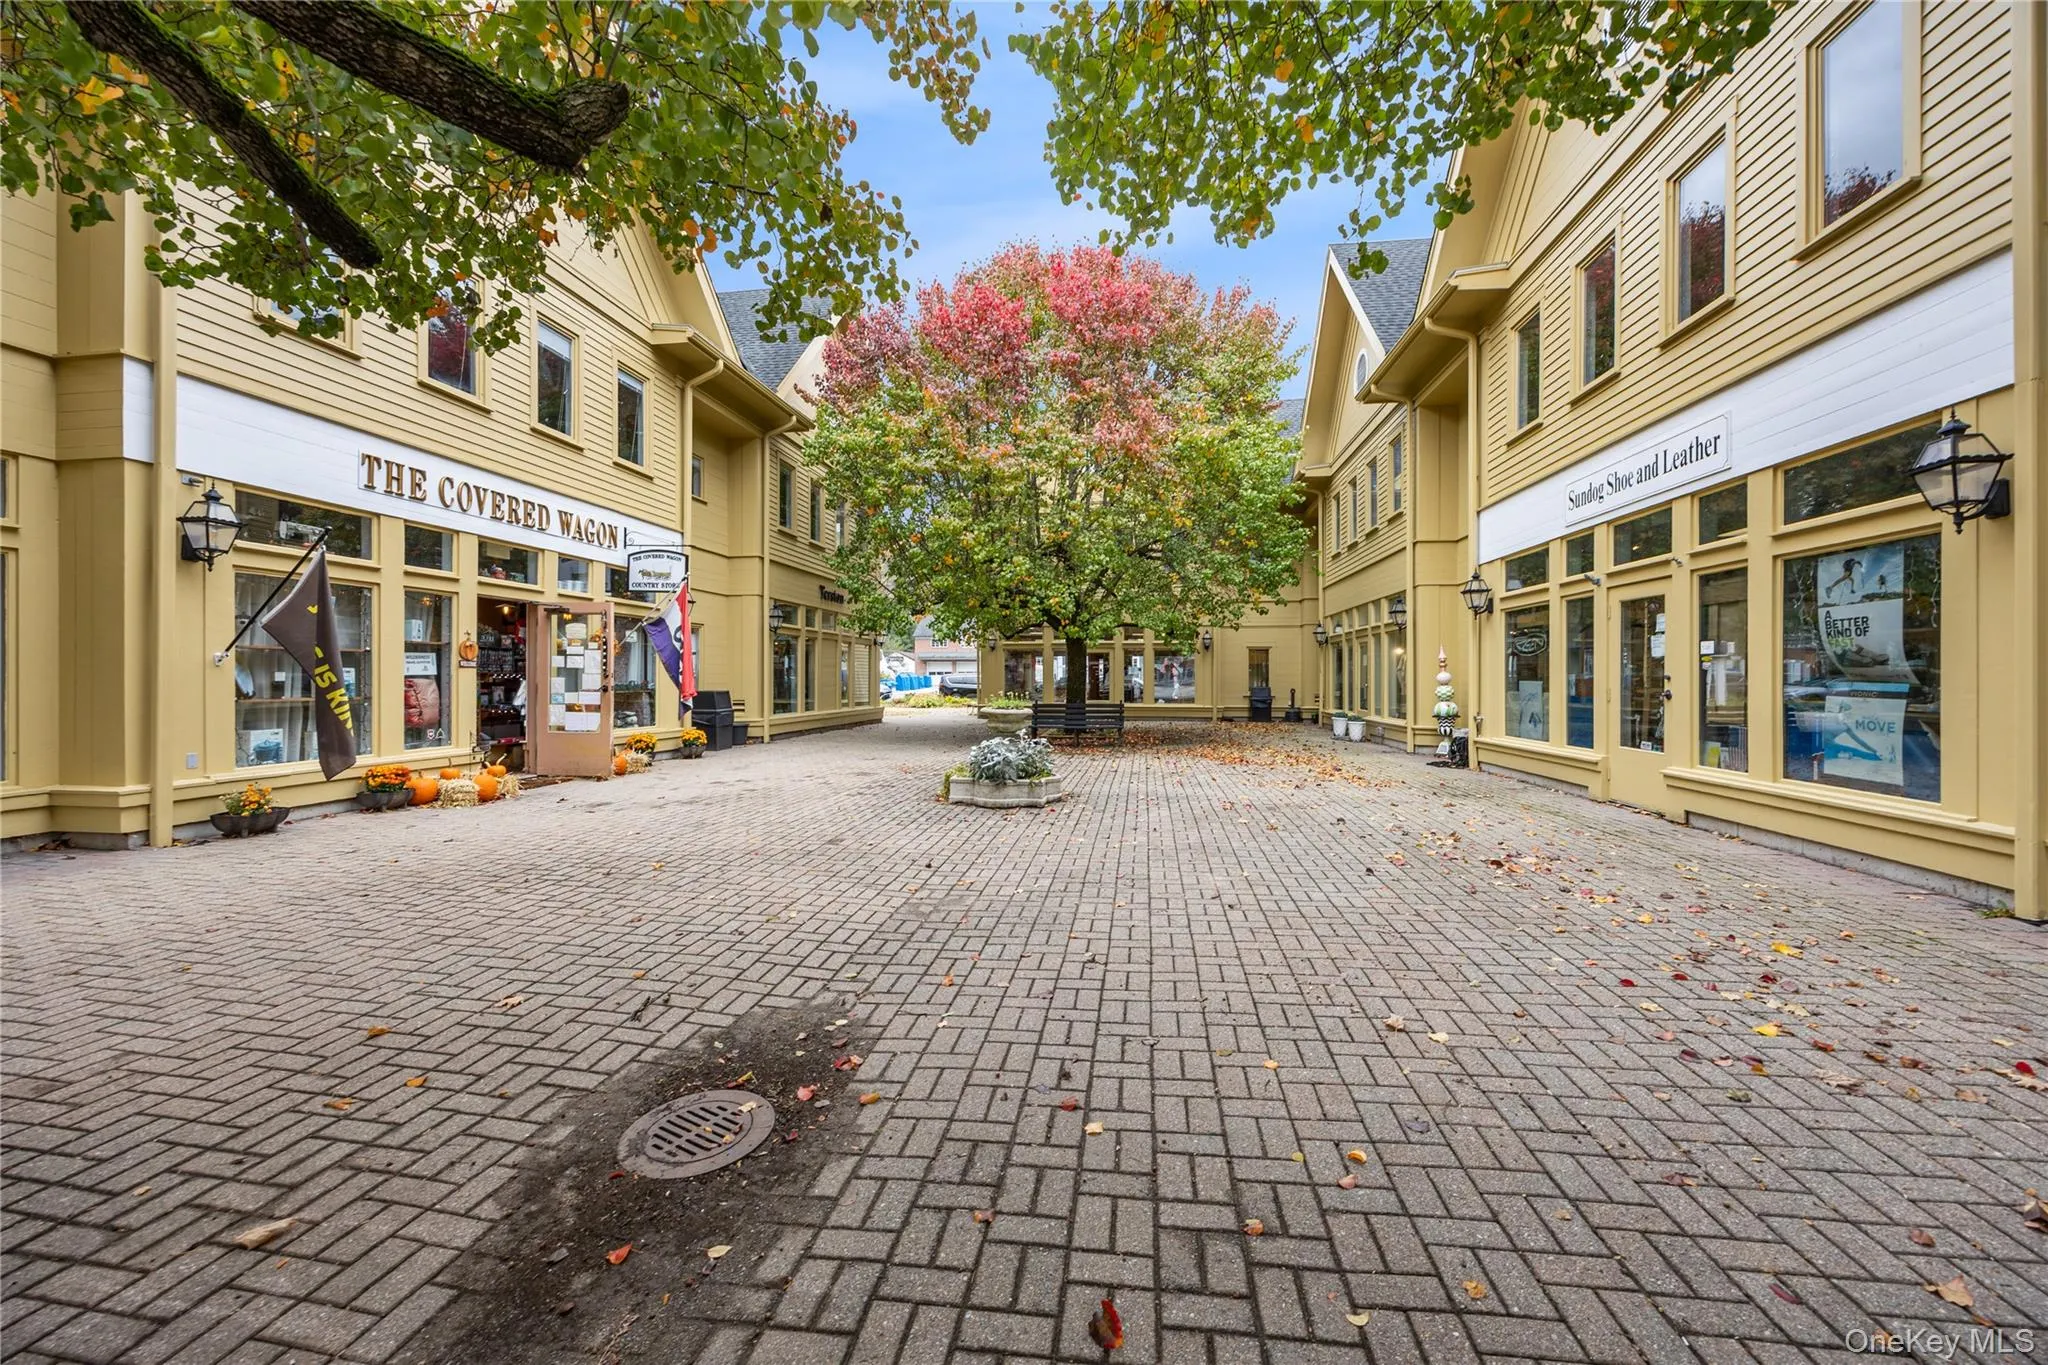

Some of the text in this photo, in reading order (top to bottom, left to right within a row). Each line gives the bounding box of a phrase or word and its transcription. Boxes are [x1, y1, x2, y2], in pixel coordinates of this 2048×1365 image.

[1568, 434, 1721, 511] Sundog Shoe and Leather
[361, 452, 619, 549] THE COVERED WAGON
[666, 554, 682, 562] WAGON
[1825, 610, 1832, 620] A
[1825, 616, 1869, 630] BETTER
[1826, 626, 1870, 639] KIND OF
[1828, 637, 1854, 649] FAST
[1855, 719, 1896, 733] MOVE
